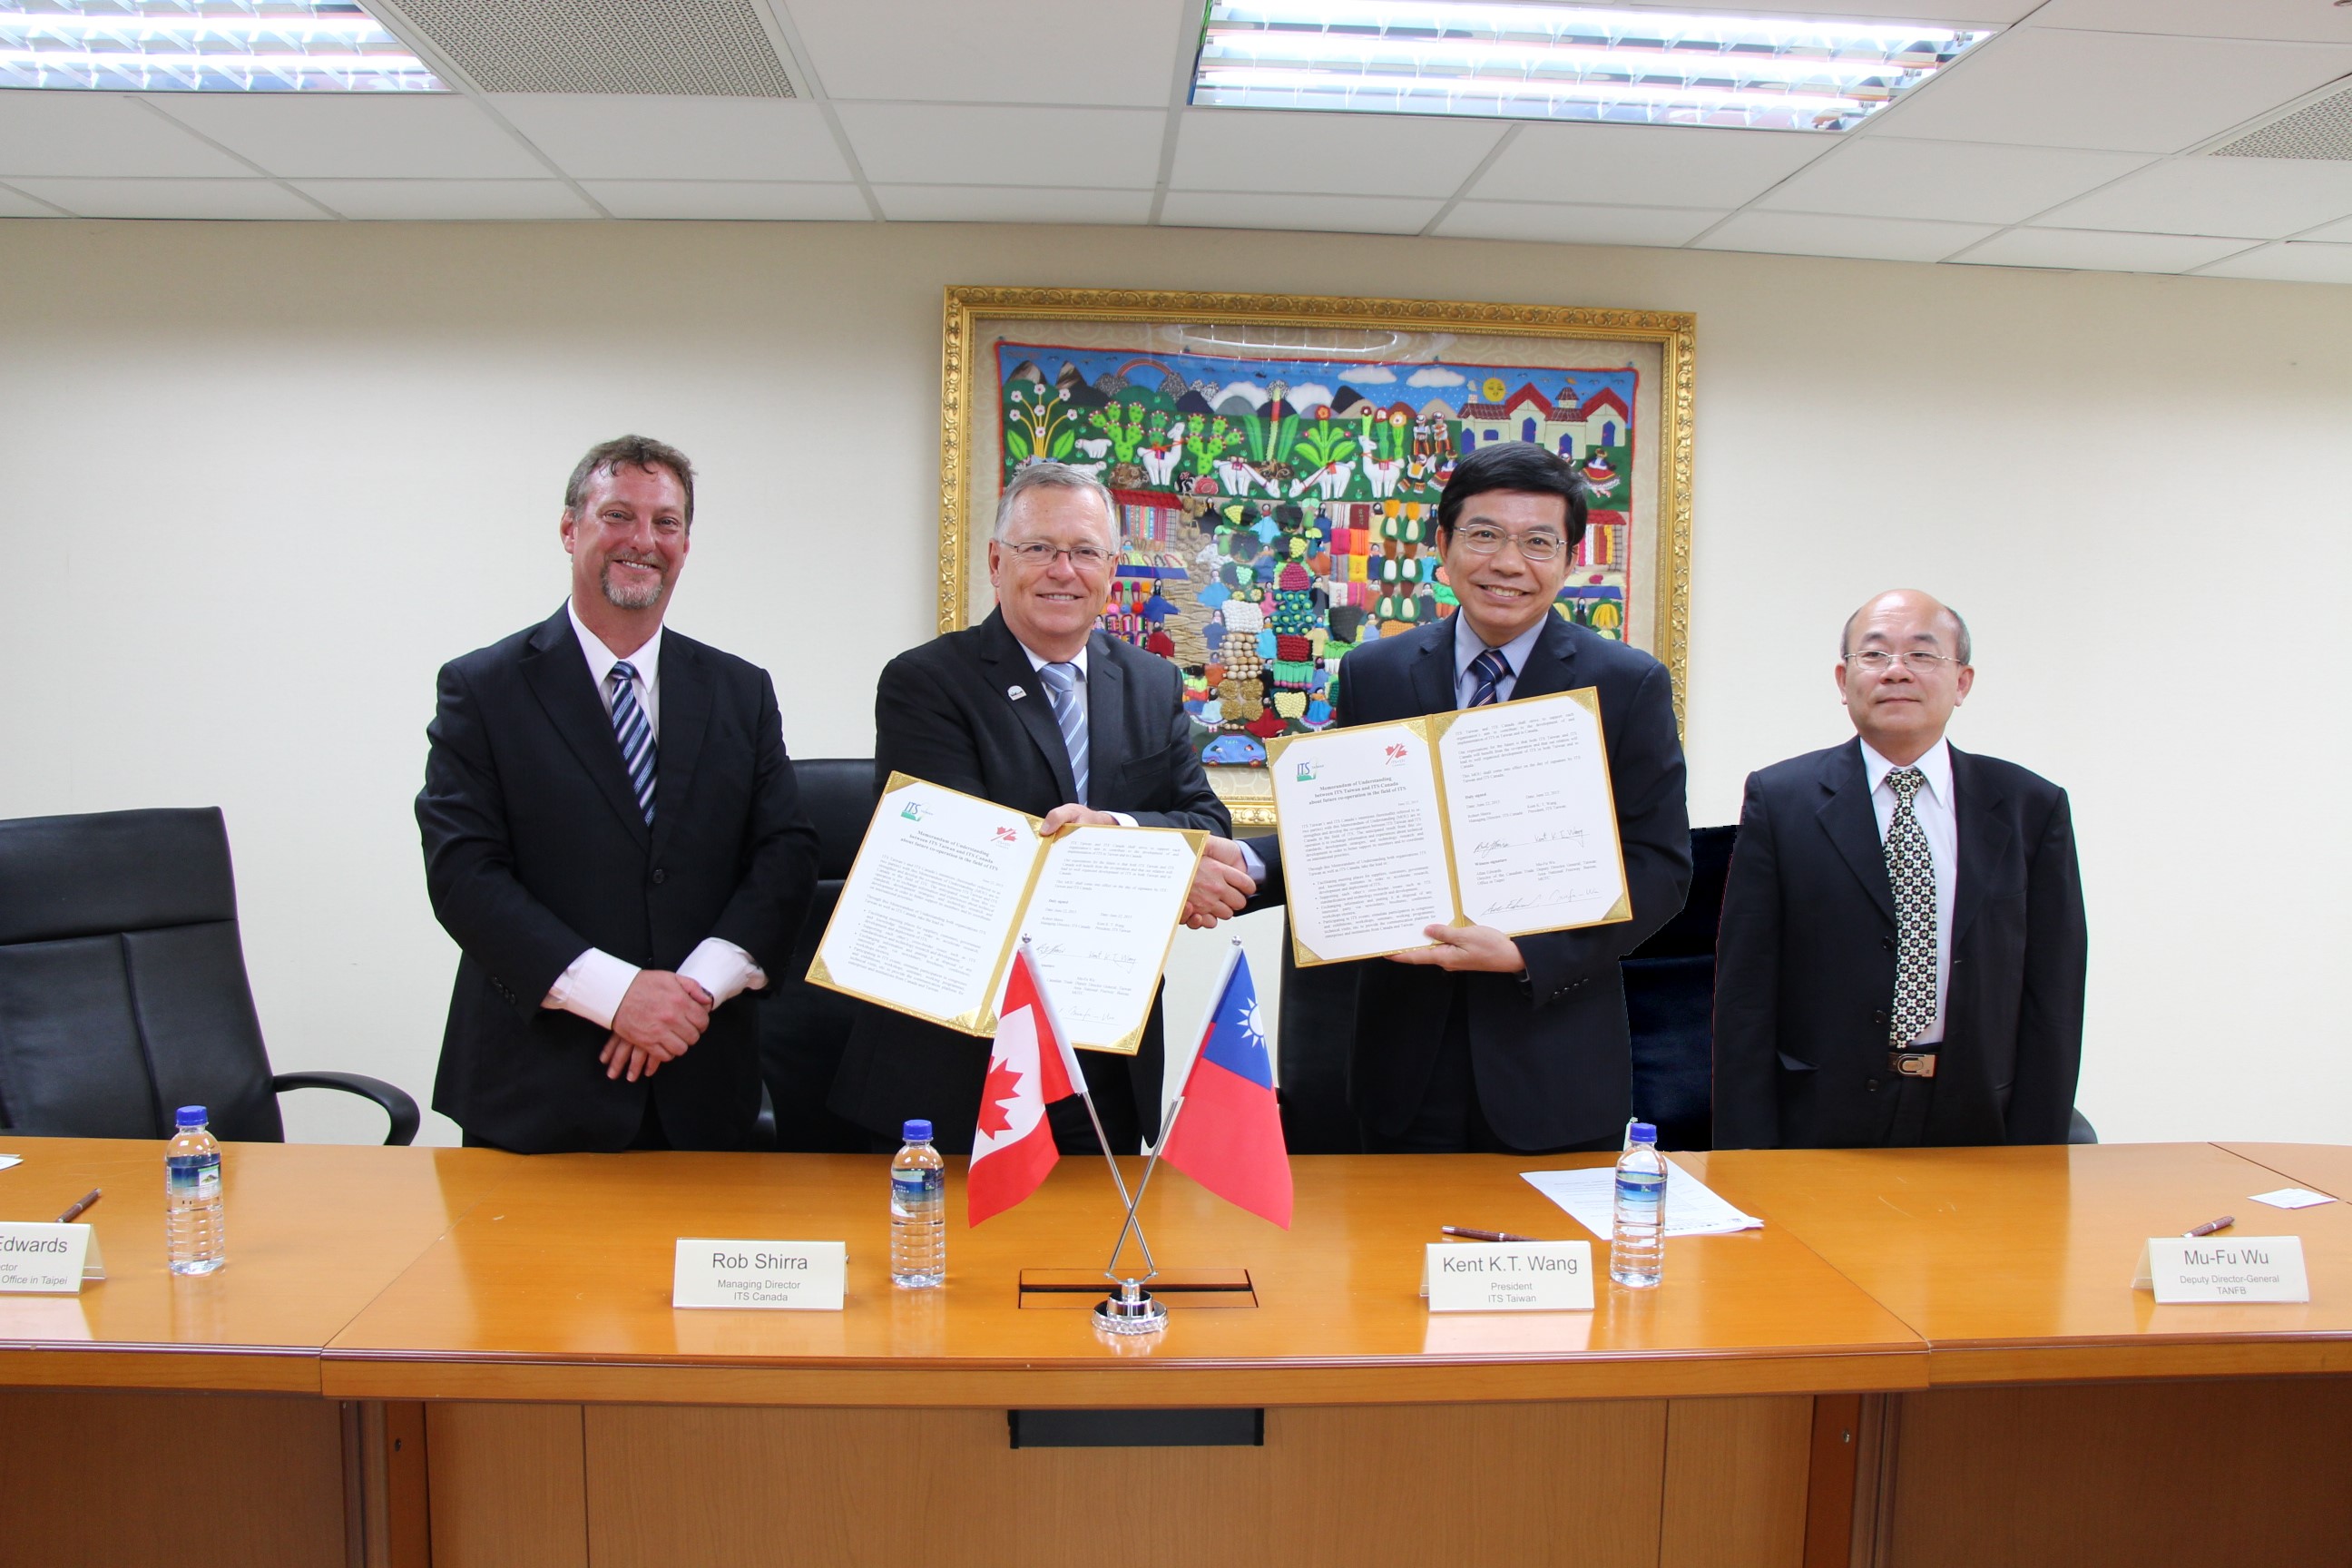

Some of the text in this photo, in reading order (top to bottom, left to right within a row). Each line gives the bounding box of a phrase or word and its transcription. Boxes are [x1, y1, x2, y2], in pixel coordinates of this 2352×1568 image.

[713, 1252, 808, 1270] Rob Shirra
[2183, 1249, 2269, 1265] Mu-Fu Wu
[1443, 1256, 1578, 1275] Kent K.T. Wang
[2, 1275, 68, 1286] Office in Taipei
[717, 1279, 800, 1290] Managing Director
[2180, 1275, 2279, 1285] Deputy Director-General
[1491, 1282, 1533, 1291] President
[2217, 1286, 2247, 1295] TANFB
[734, 1292, 788, 1301] ITS Canada
[1488, 1294, 1536, 1303] ITS Taiwan
